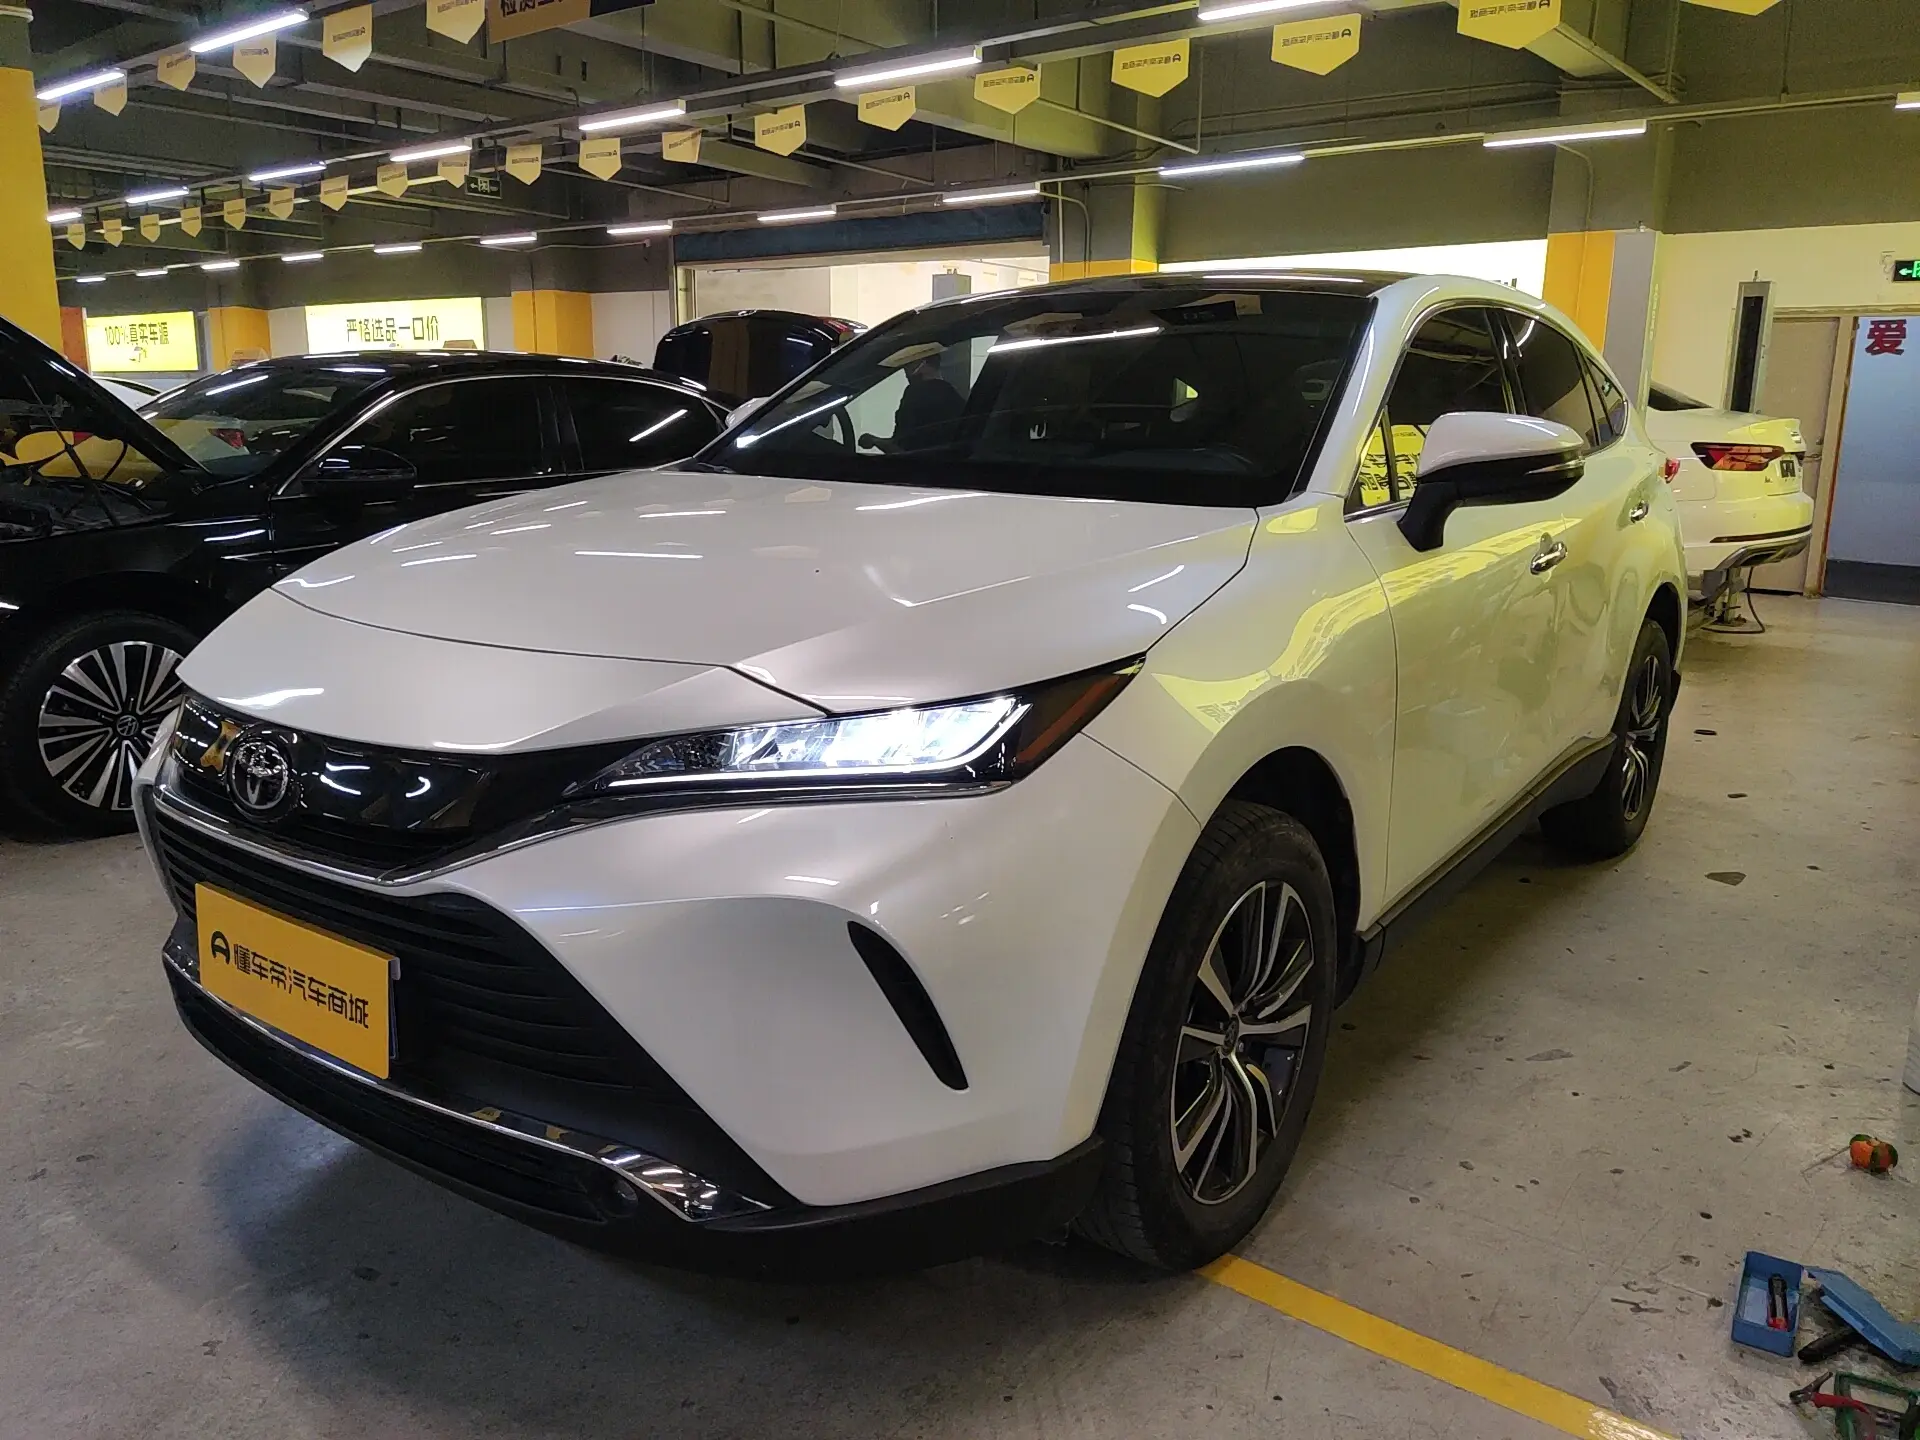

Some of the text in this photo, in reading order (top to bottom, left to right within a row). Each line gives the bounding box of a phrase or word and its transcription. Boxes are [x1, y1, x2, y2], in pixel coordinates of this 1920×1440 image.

[346, 315, 439, 342] 严格选品一口价
[1865, 319, 1907, 355] 爱
[234, 943, 369, 1029] 懂车帝汽车商城
